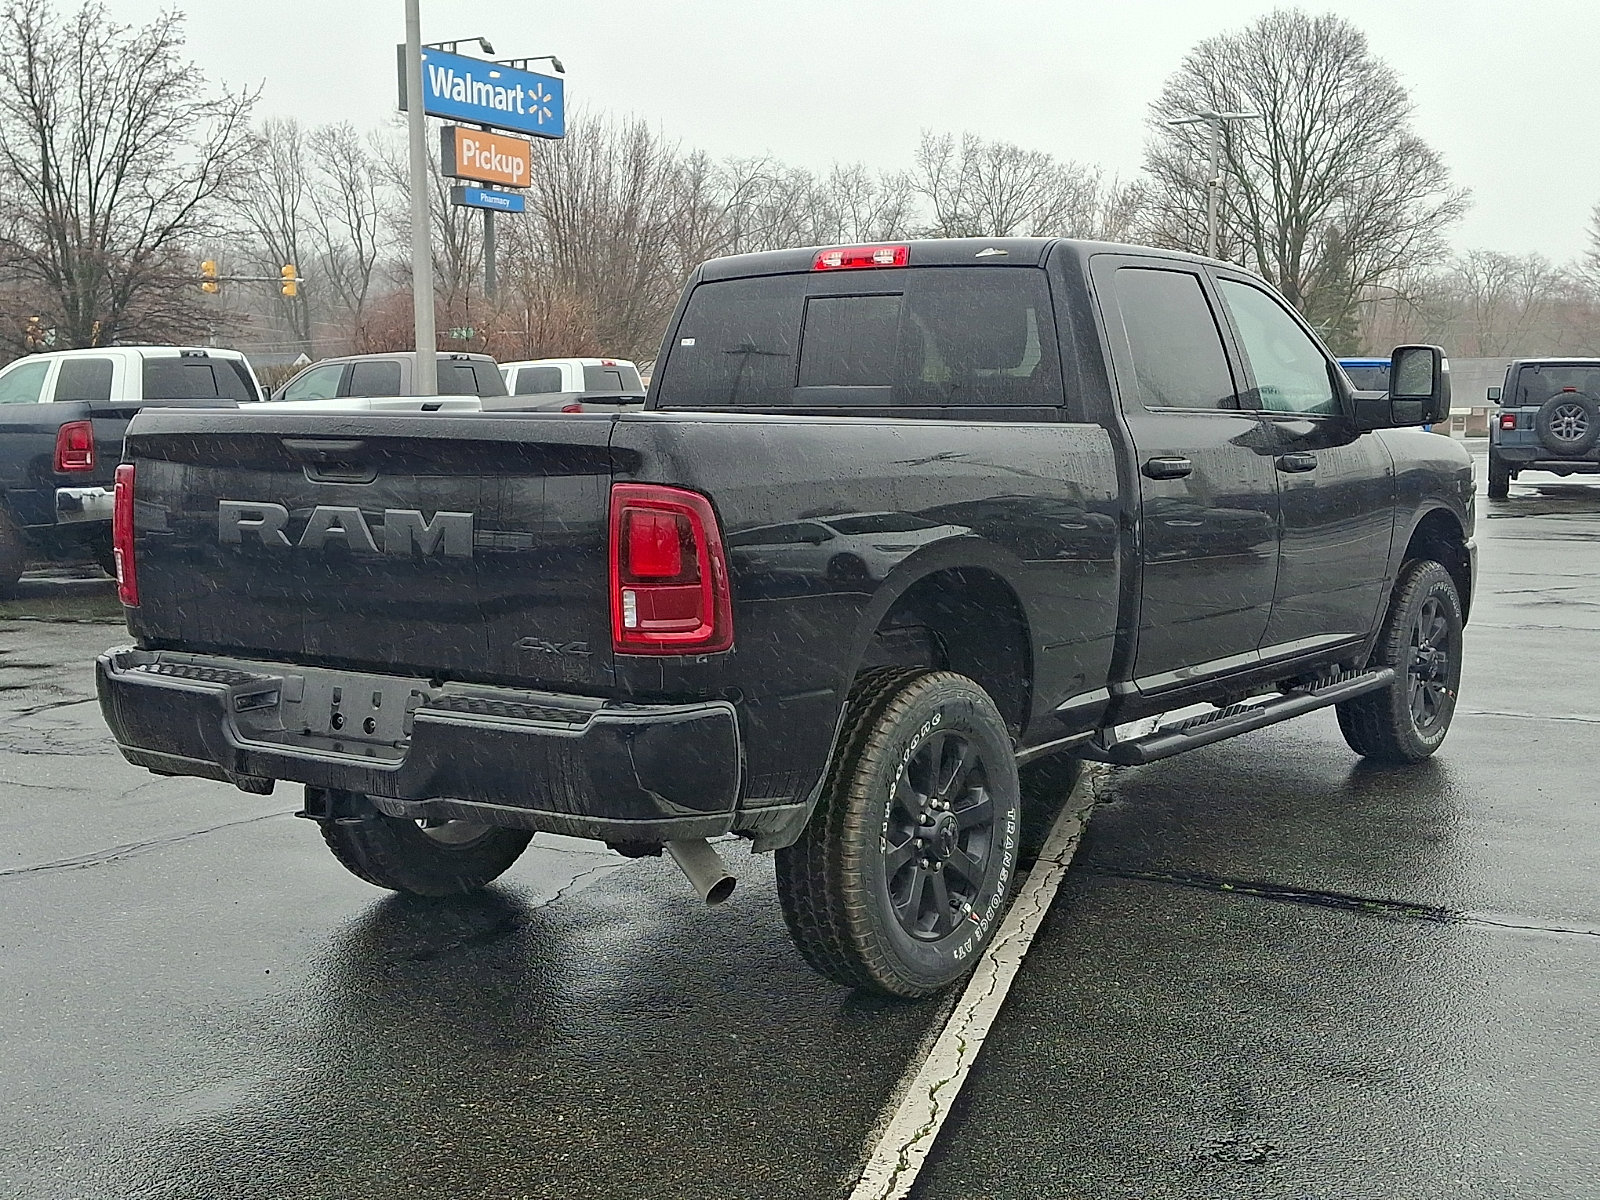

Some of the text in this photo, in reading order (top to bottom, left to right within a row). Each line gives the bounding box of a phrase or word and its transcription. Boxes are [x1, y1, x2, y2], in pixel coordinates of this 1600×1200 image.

[428, 64, 525, 115] Walmart
[462, 138, 524, 183] Pickup
[480, 193, 510, 207] Pharmacy
[218, 499, 475, 558] RAM
